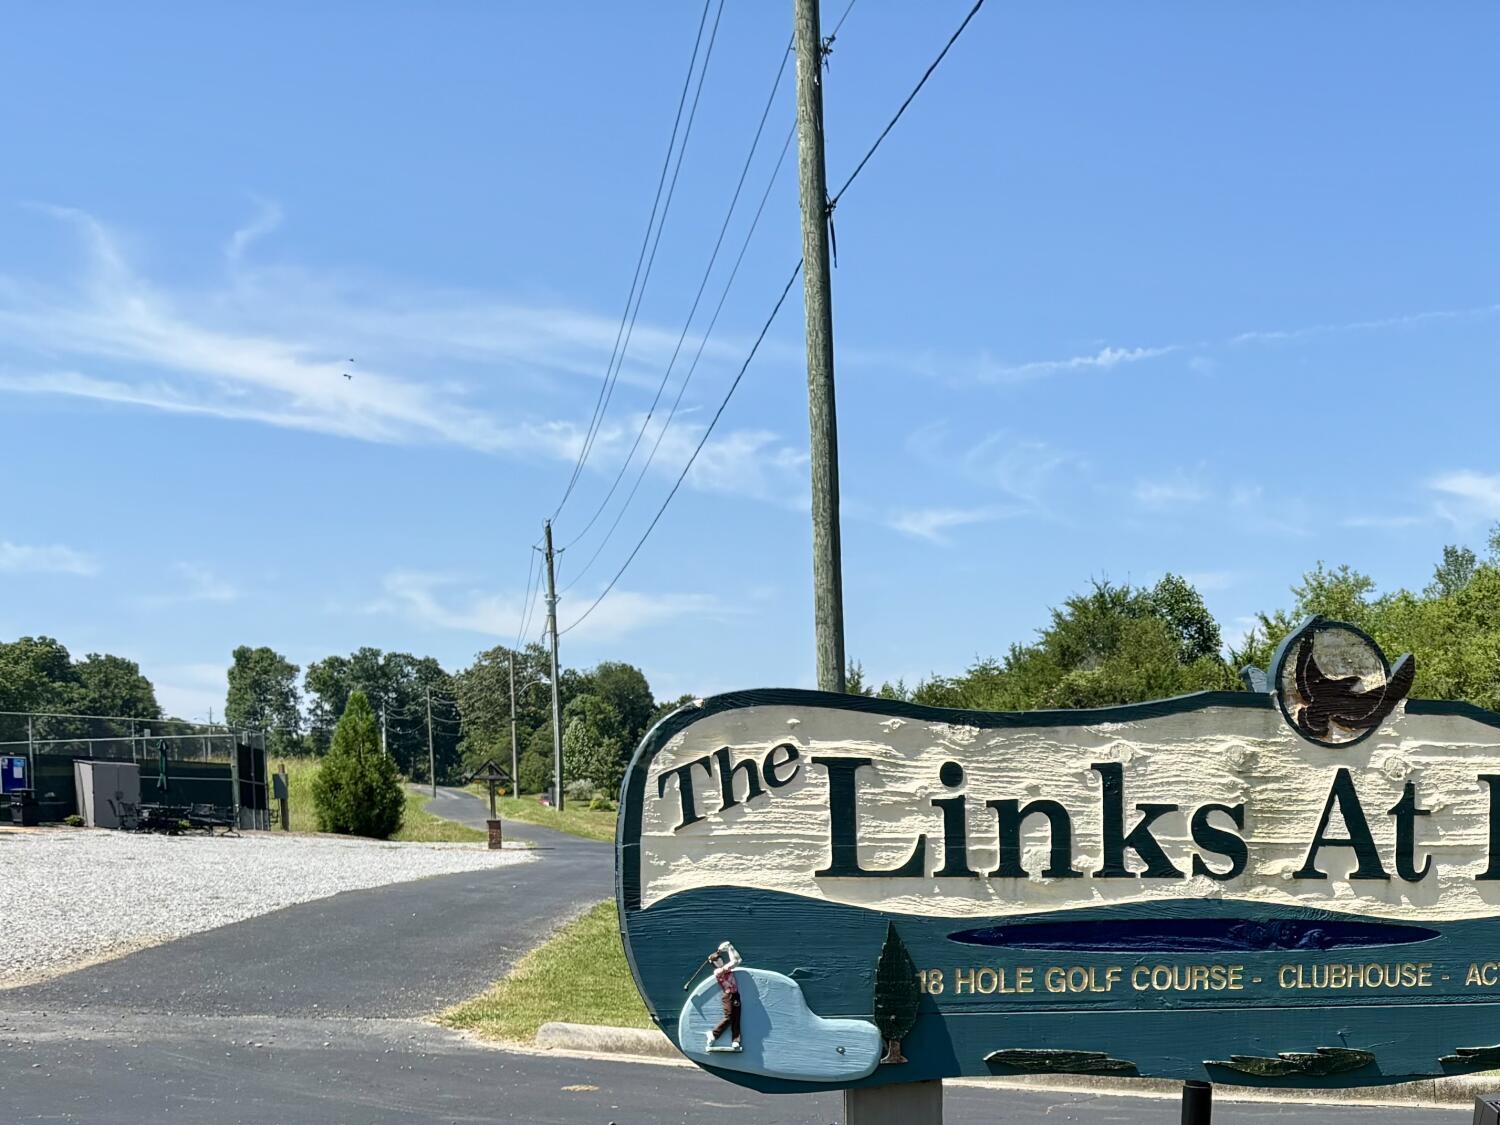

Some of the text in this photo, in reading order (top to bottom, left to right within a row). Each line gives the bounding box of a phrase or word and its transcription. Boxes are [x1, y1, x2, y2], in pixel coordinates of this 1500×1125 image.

[658, 742, 799, 830] The
[811, 757, 1248, 880] Links
[1293, 768, 1431, 882] At
[917, 969, 943, 995] 18
[955, 968, 1034, 994] HOLE
[1044, 967, 1122, 993] GOLF
[1131, 965, 1244, 991] COURSE
[1278, 963, 1432, 989] CLUBHOUSE
